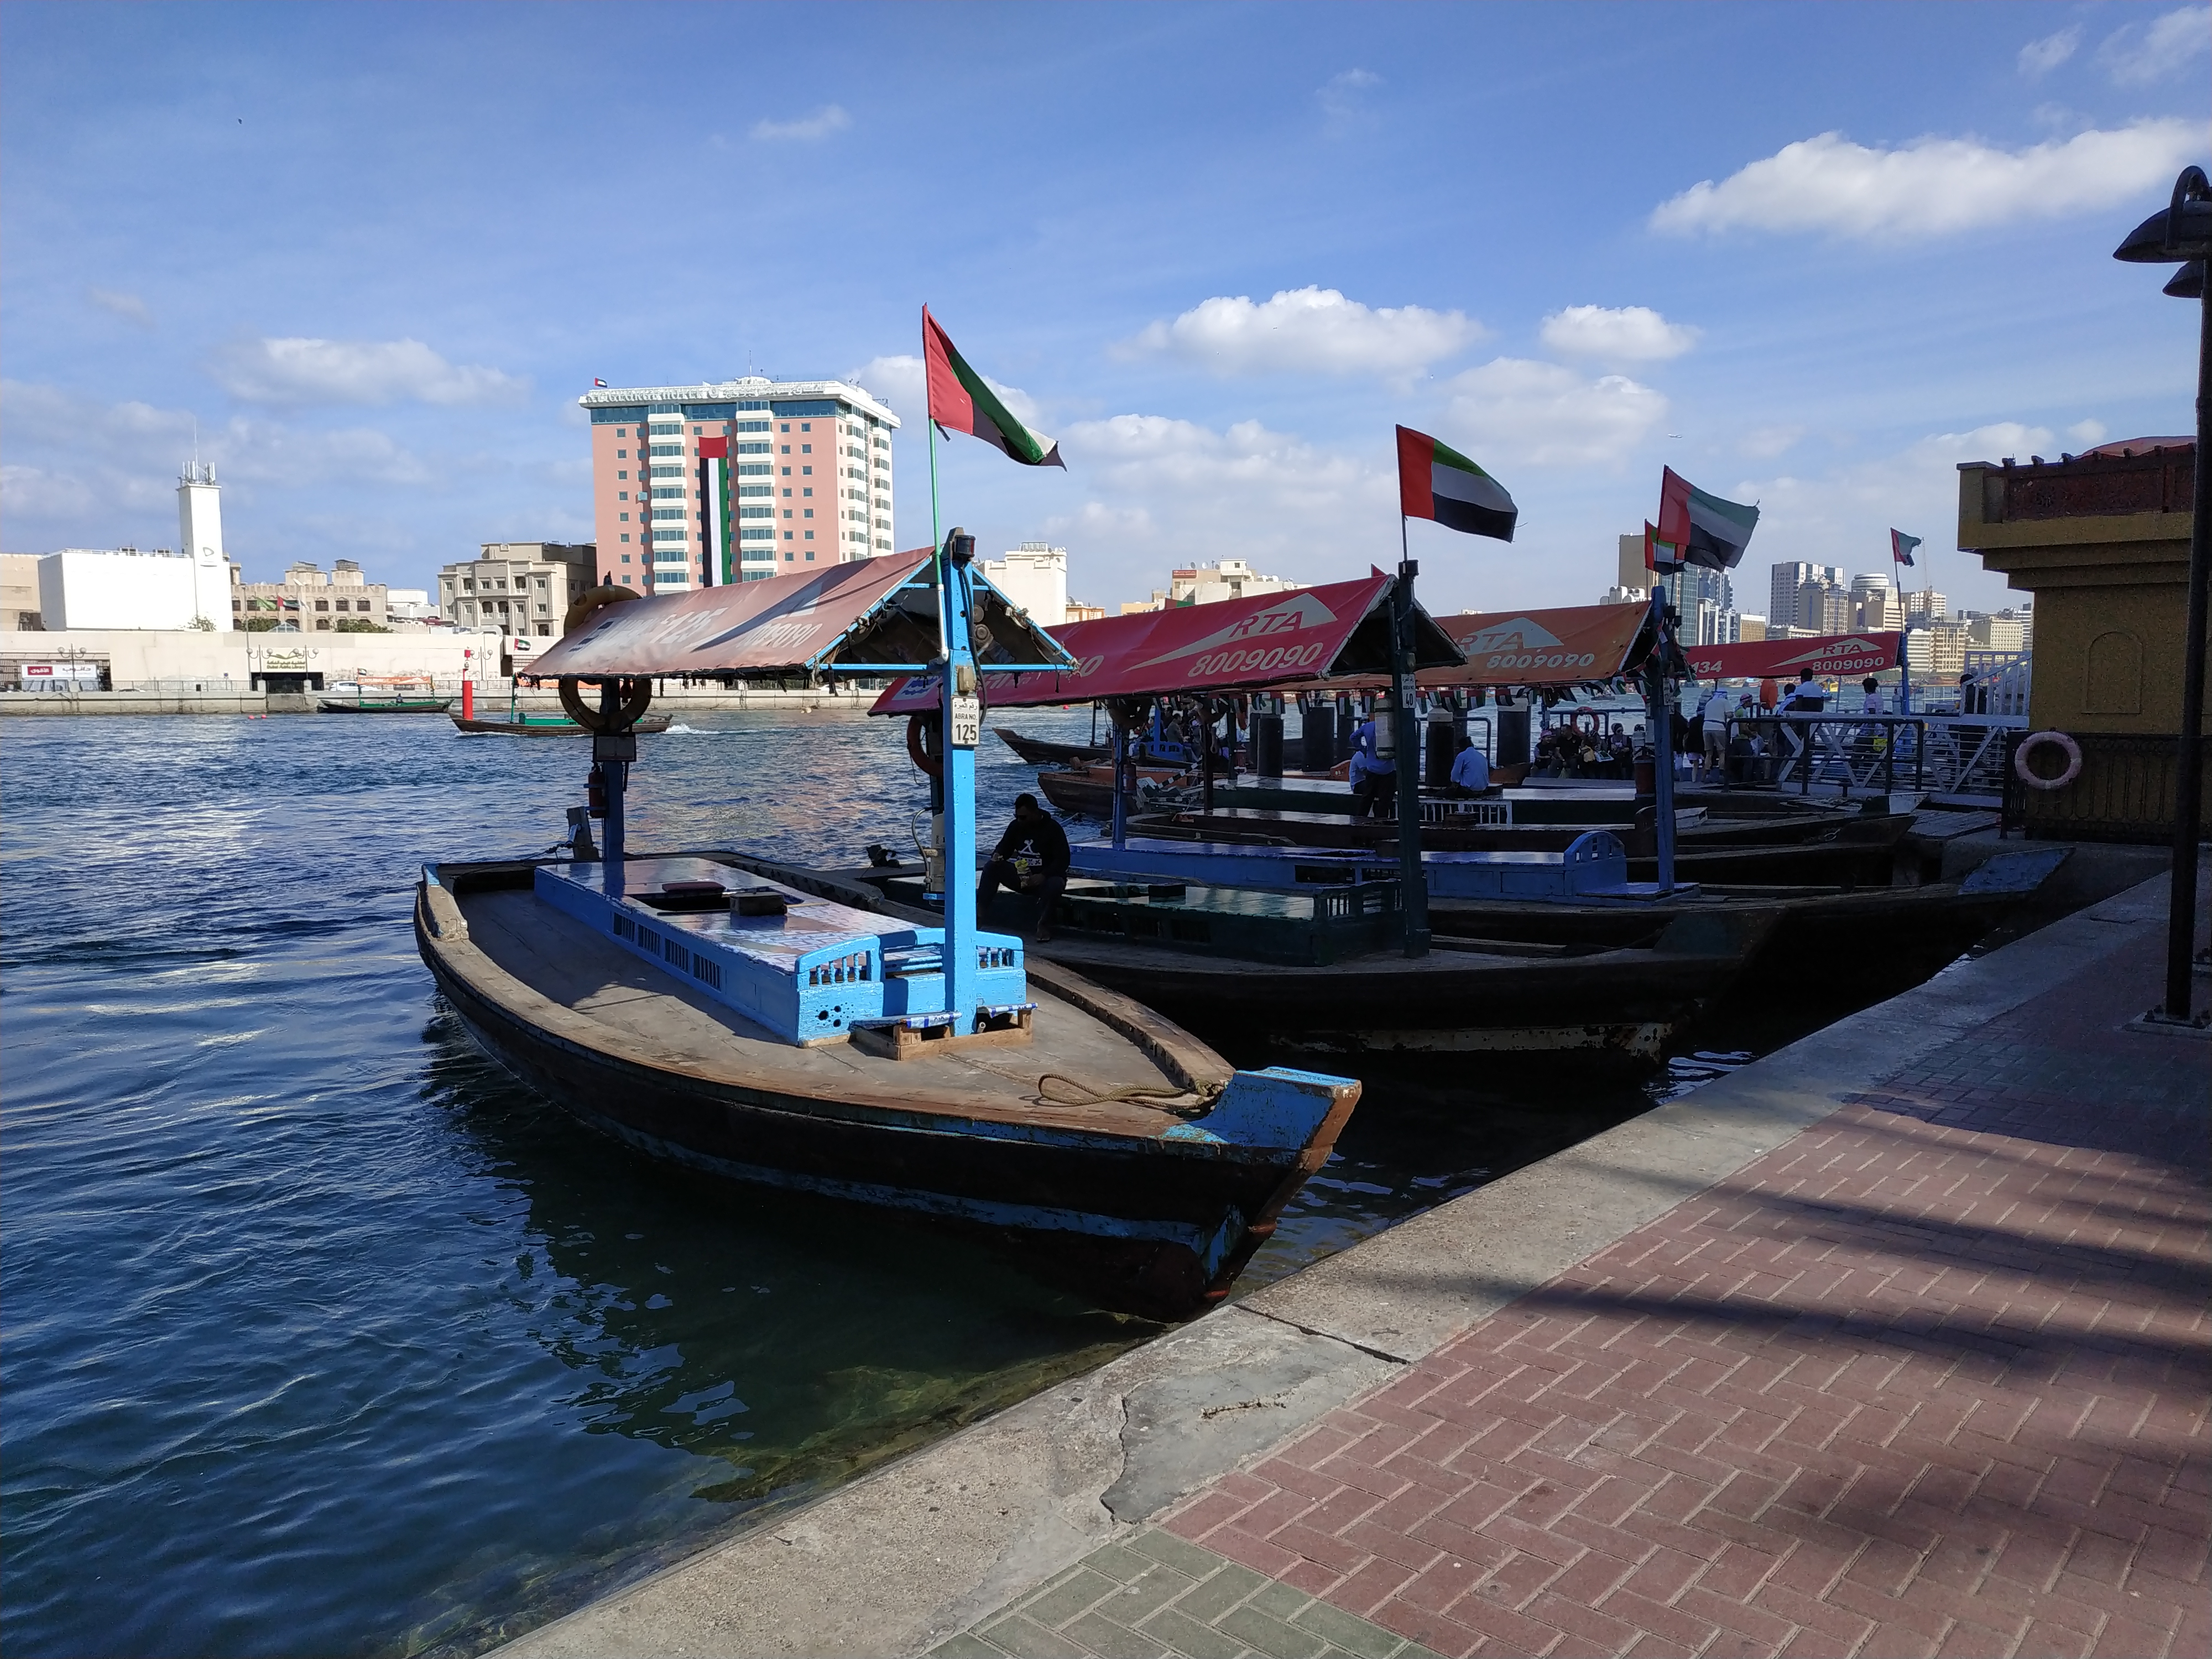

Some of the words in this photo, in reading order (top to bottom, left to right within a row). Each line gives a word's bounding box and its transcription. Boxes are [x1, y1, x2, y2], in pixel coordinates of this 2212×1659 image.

[1229, 611, 1303, 638] RTA
[1456, 632, 1524, 651] RTA
[1823, 644, 1861, 655] RTA
[1188, 642, 1323, 677] 8009090
[1486, 653, 1595, 669] 8009090
[1812, 656, 1885, 671] 8009090
[954, 701, 968, 710] العبرة
[969, 702, 978, 711] رقم
[1406, 693, 1413, 706] 40
[956, 723, 977, 741] 125
